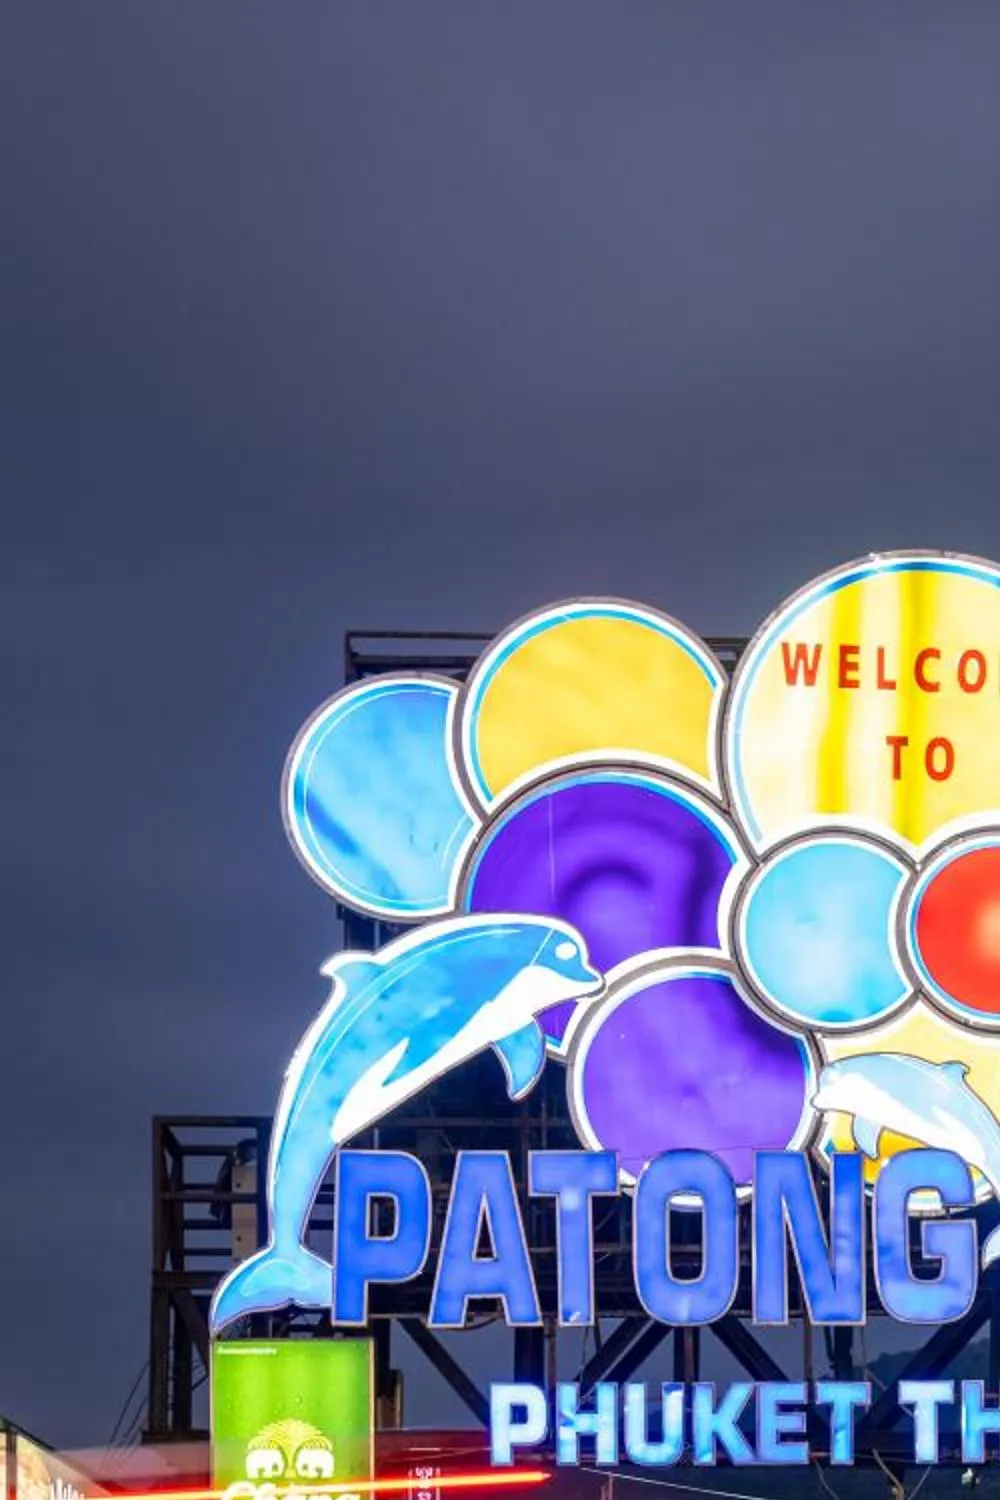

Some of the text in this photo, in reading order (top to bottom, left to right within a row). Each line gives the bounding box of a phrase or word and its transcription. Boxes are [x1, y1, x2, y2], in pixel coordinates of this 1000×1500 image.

[886, 736, 954, 781] TO
[331, 1147, 979, 1327] PATONG
[490, 1380, 871, 1466] PHUKET
